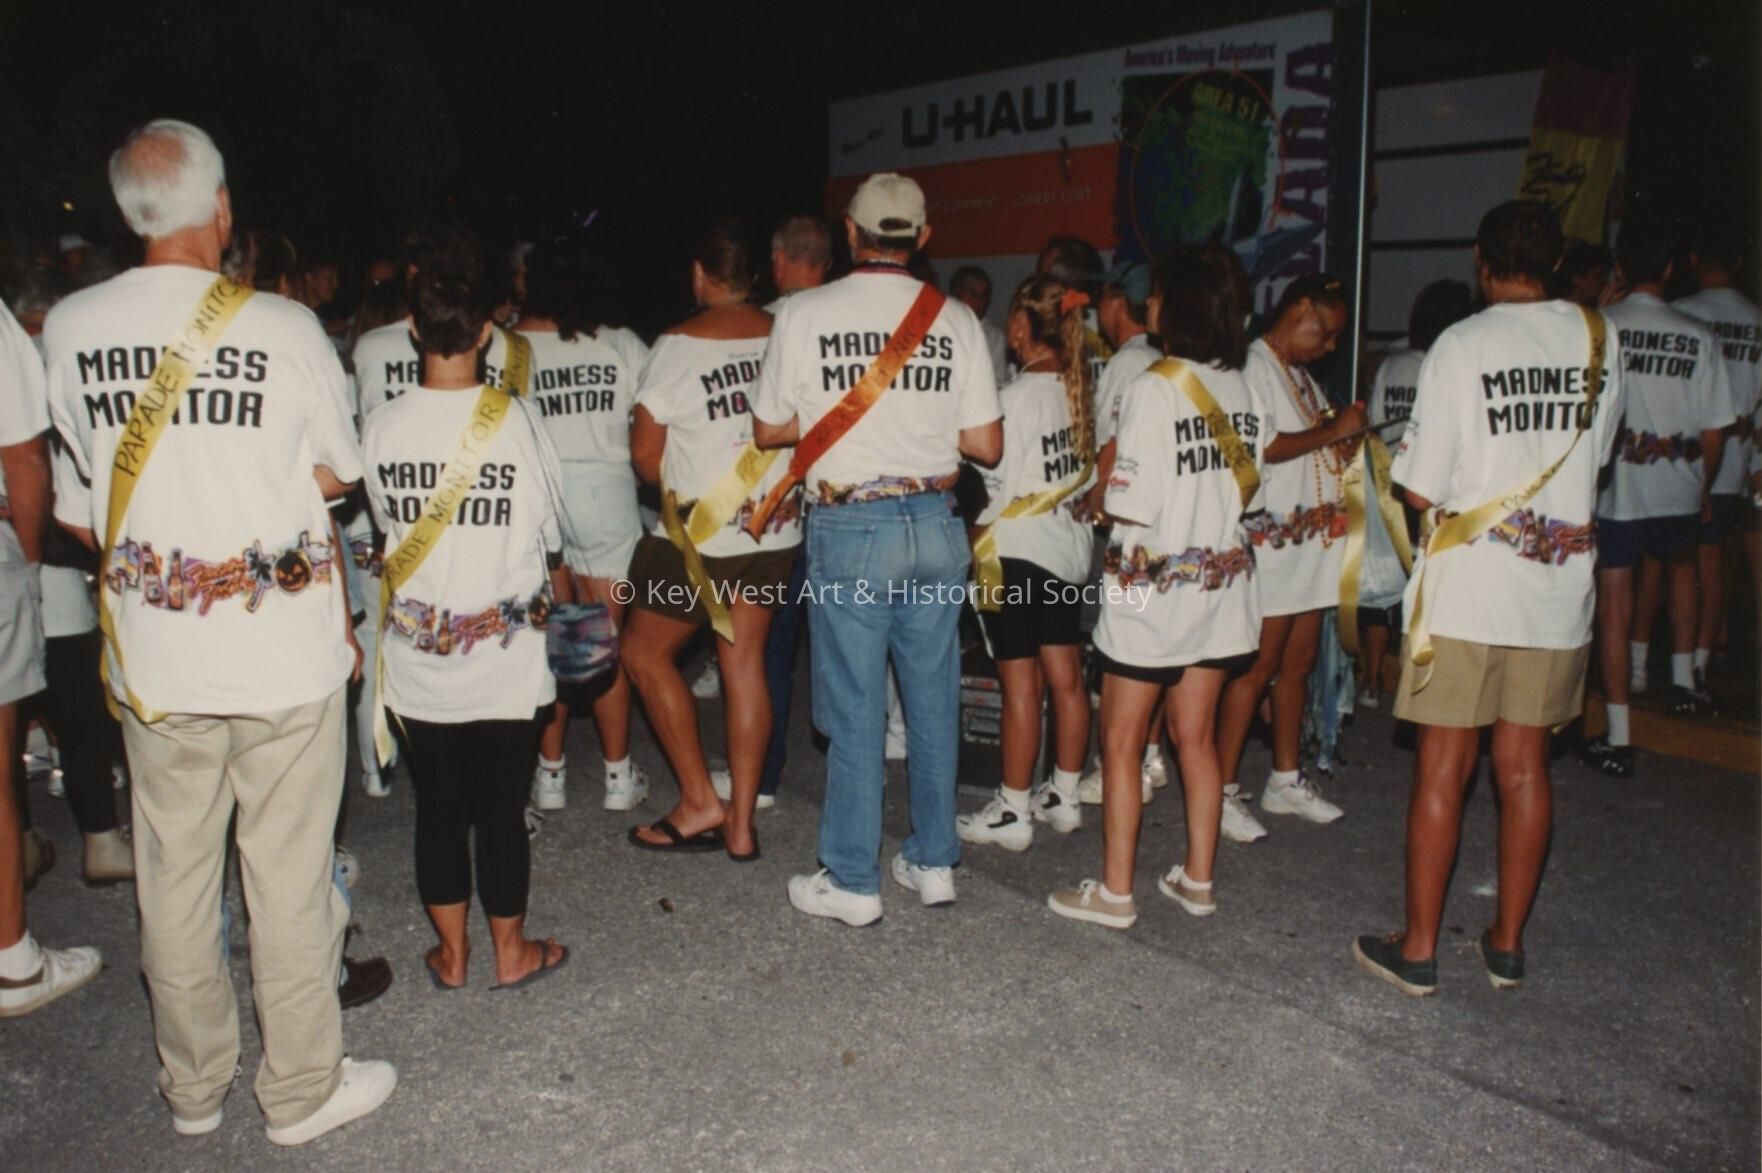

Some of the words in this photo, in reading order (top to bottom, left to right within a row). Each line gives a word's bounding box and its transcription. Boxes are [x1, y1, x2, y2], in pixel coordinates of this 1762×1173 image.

[902, 79, 1093, 148] U-HAUL
[819, 332, 953, 361] MADSS
[76, 346, 268, 384] MADSS
[822, 363, 953, 392] MOTOR
[83, 388, 264, 428] MOTOR
[114, 367, 179, 477] PARADE
[377, 461, 516, 490] MADSS
[384, 494, 512, 526] MOTOR
